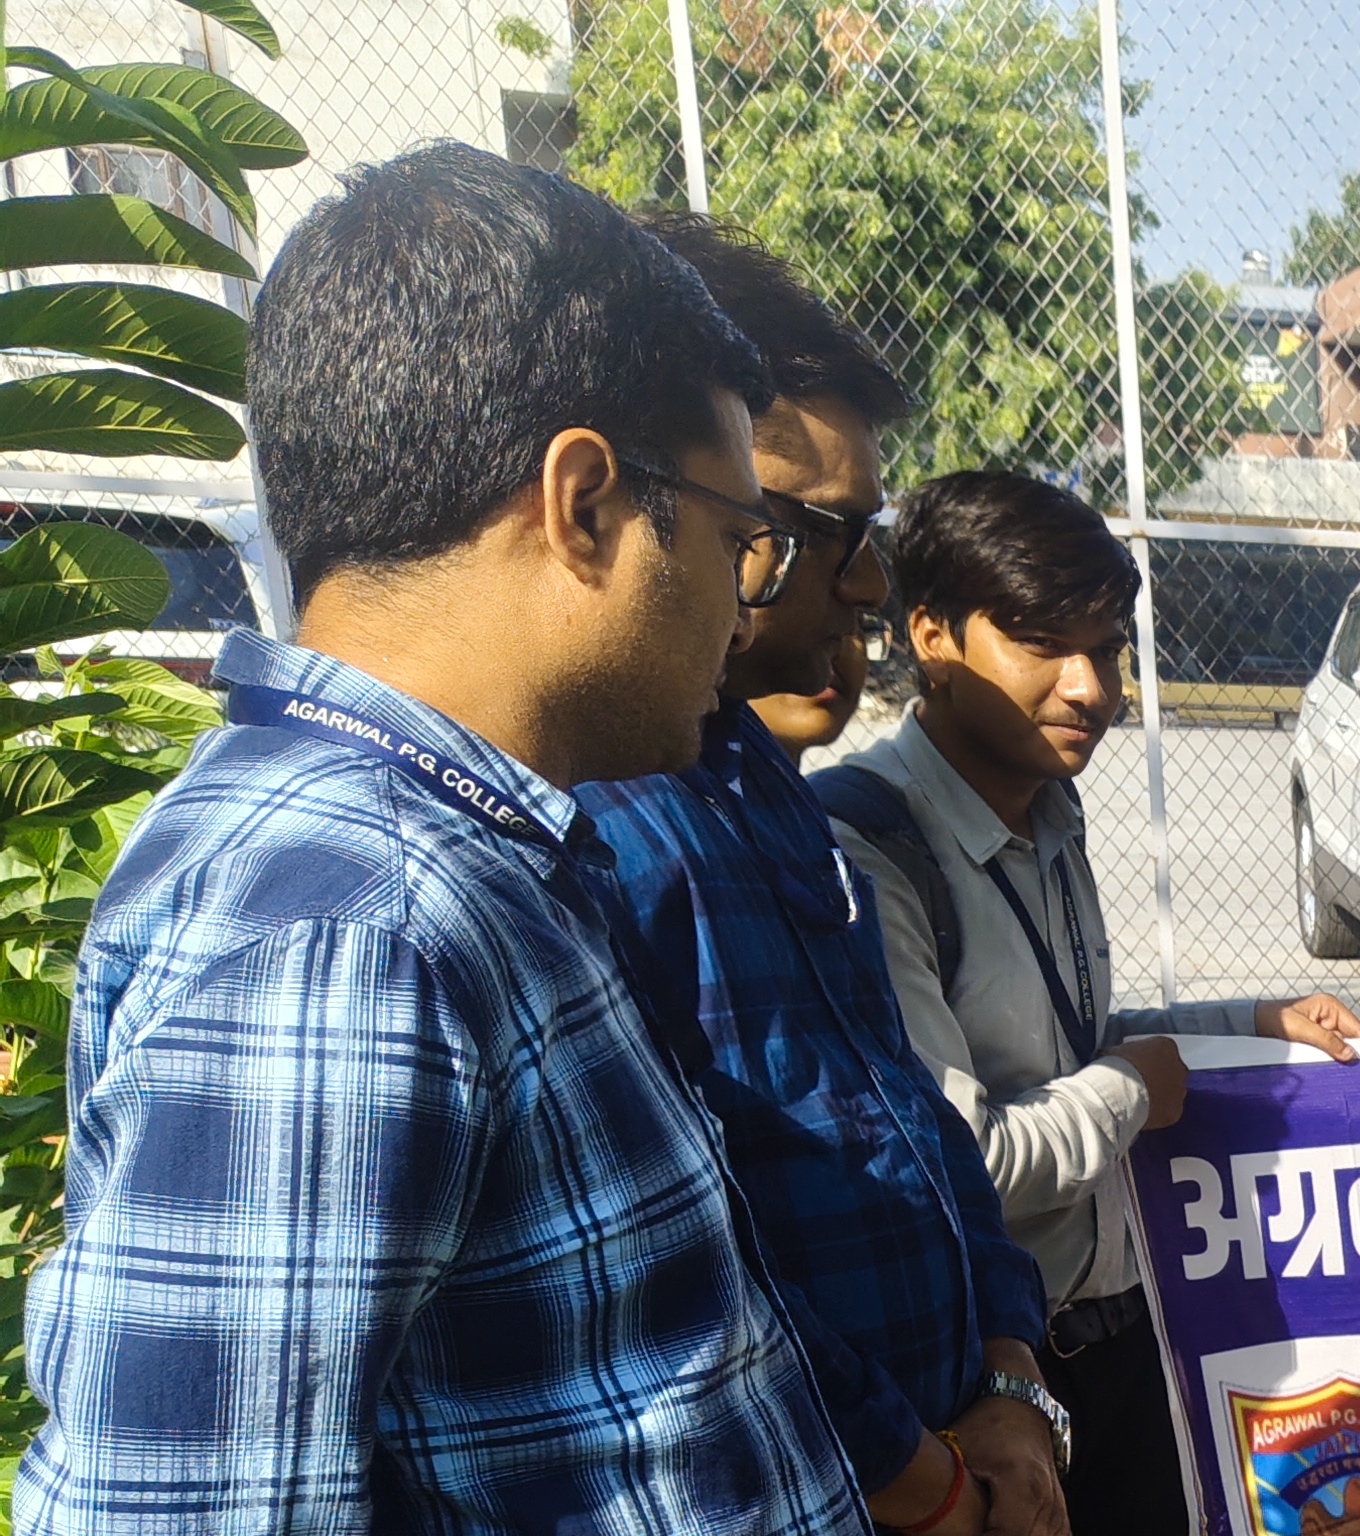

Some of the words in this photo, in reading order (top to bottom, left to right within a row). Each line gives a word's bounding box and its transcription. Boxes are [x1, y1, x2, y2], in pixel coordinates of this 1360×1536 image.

[283, 699, 393, 750] AGARWAL
[397, 742, 437, 775] P.G.
[441, 766, 541, 838] COLLEGE
[1252, 1411, 1327, 1451] AGRAWAL
